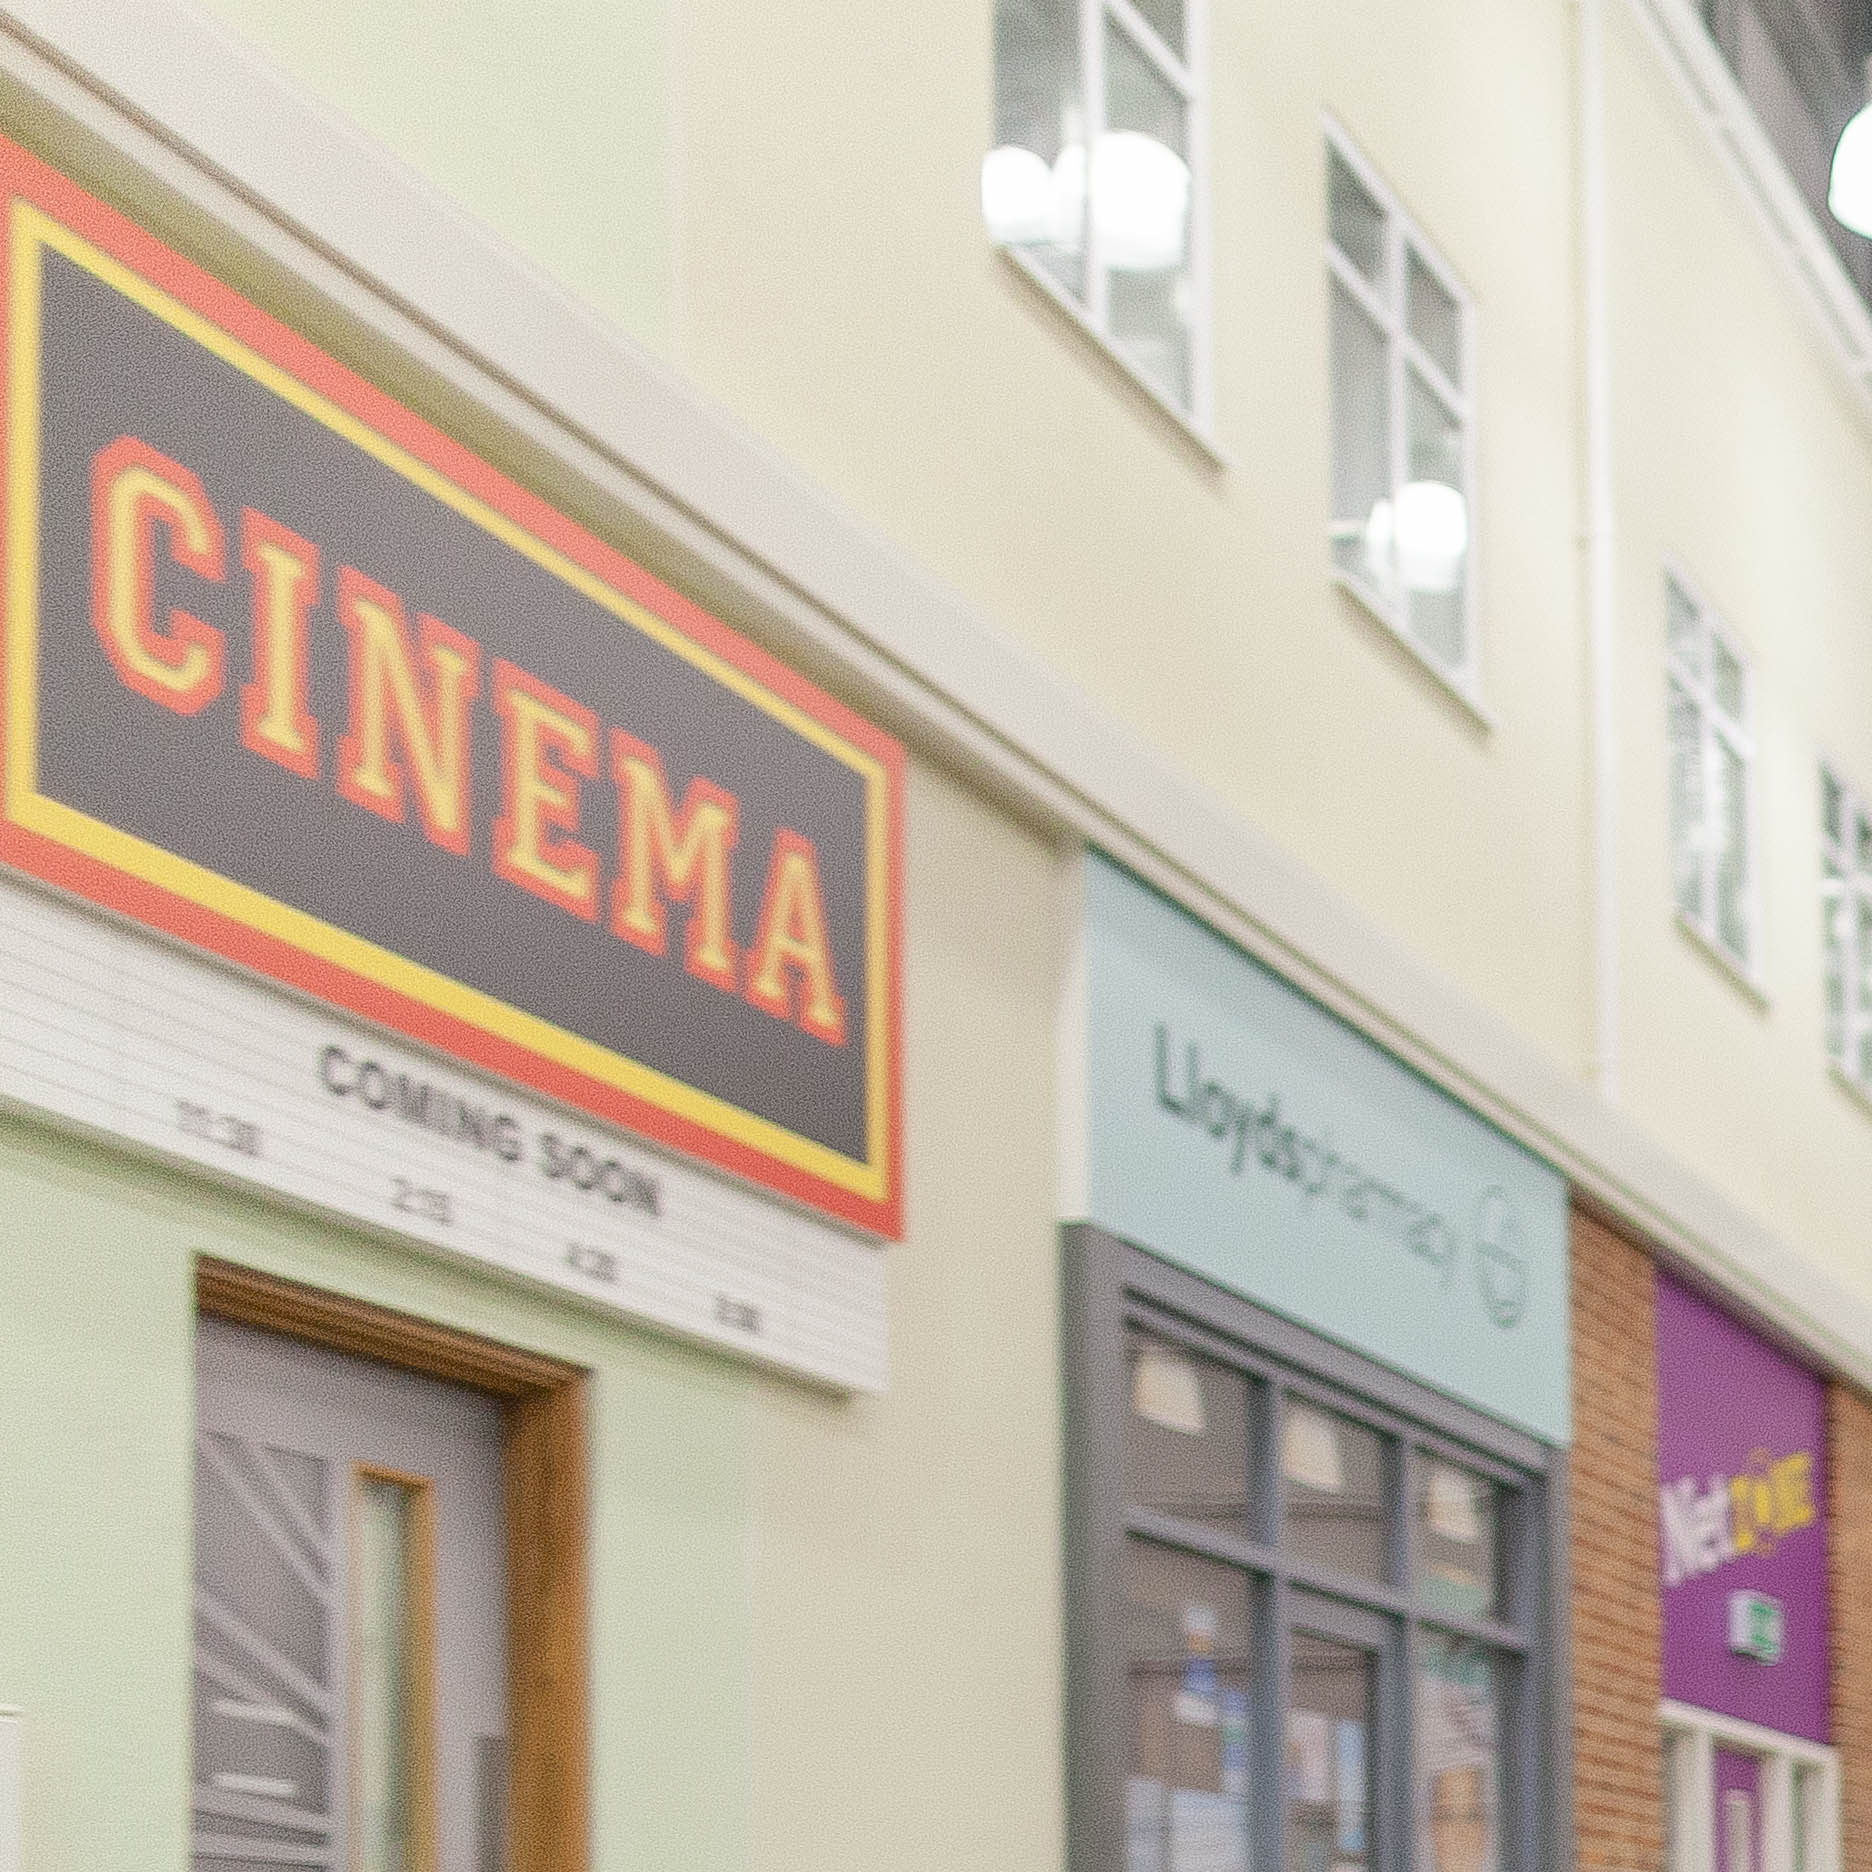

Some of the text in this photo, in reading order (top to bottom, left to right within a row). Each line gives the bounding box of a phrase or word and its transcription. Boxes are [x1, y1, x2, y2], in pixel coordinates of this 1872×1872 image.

[90, 436, 848, 1047] CINEMA
[316, 1045, 666, 1218] COMING SOON
